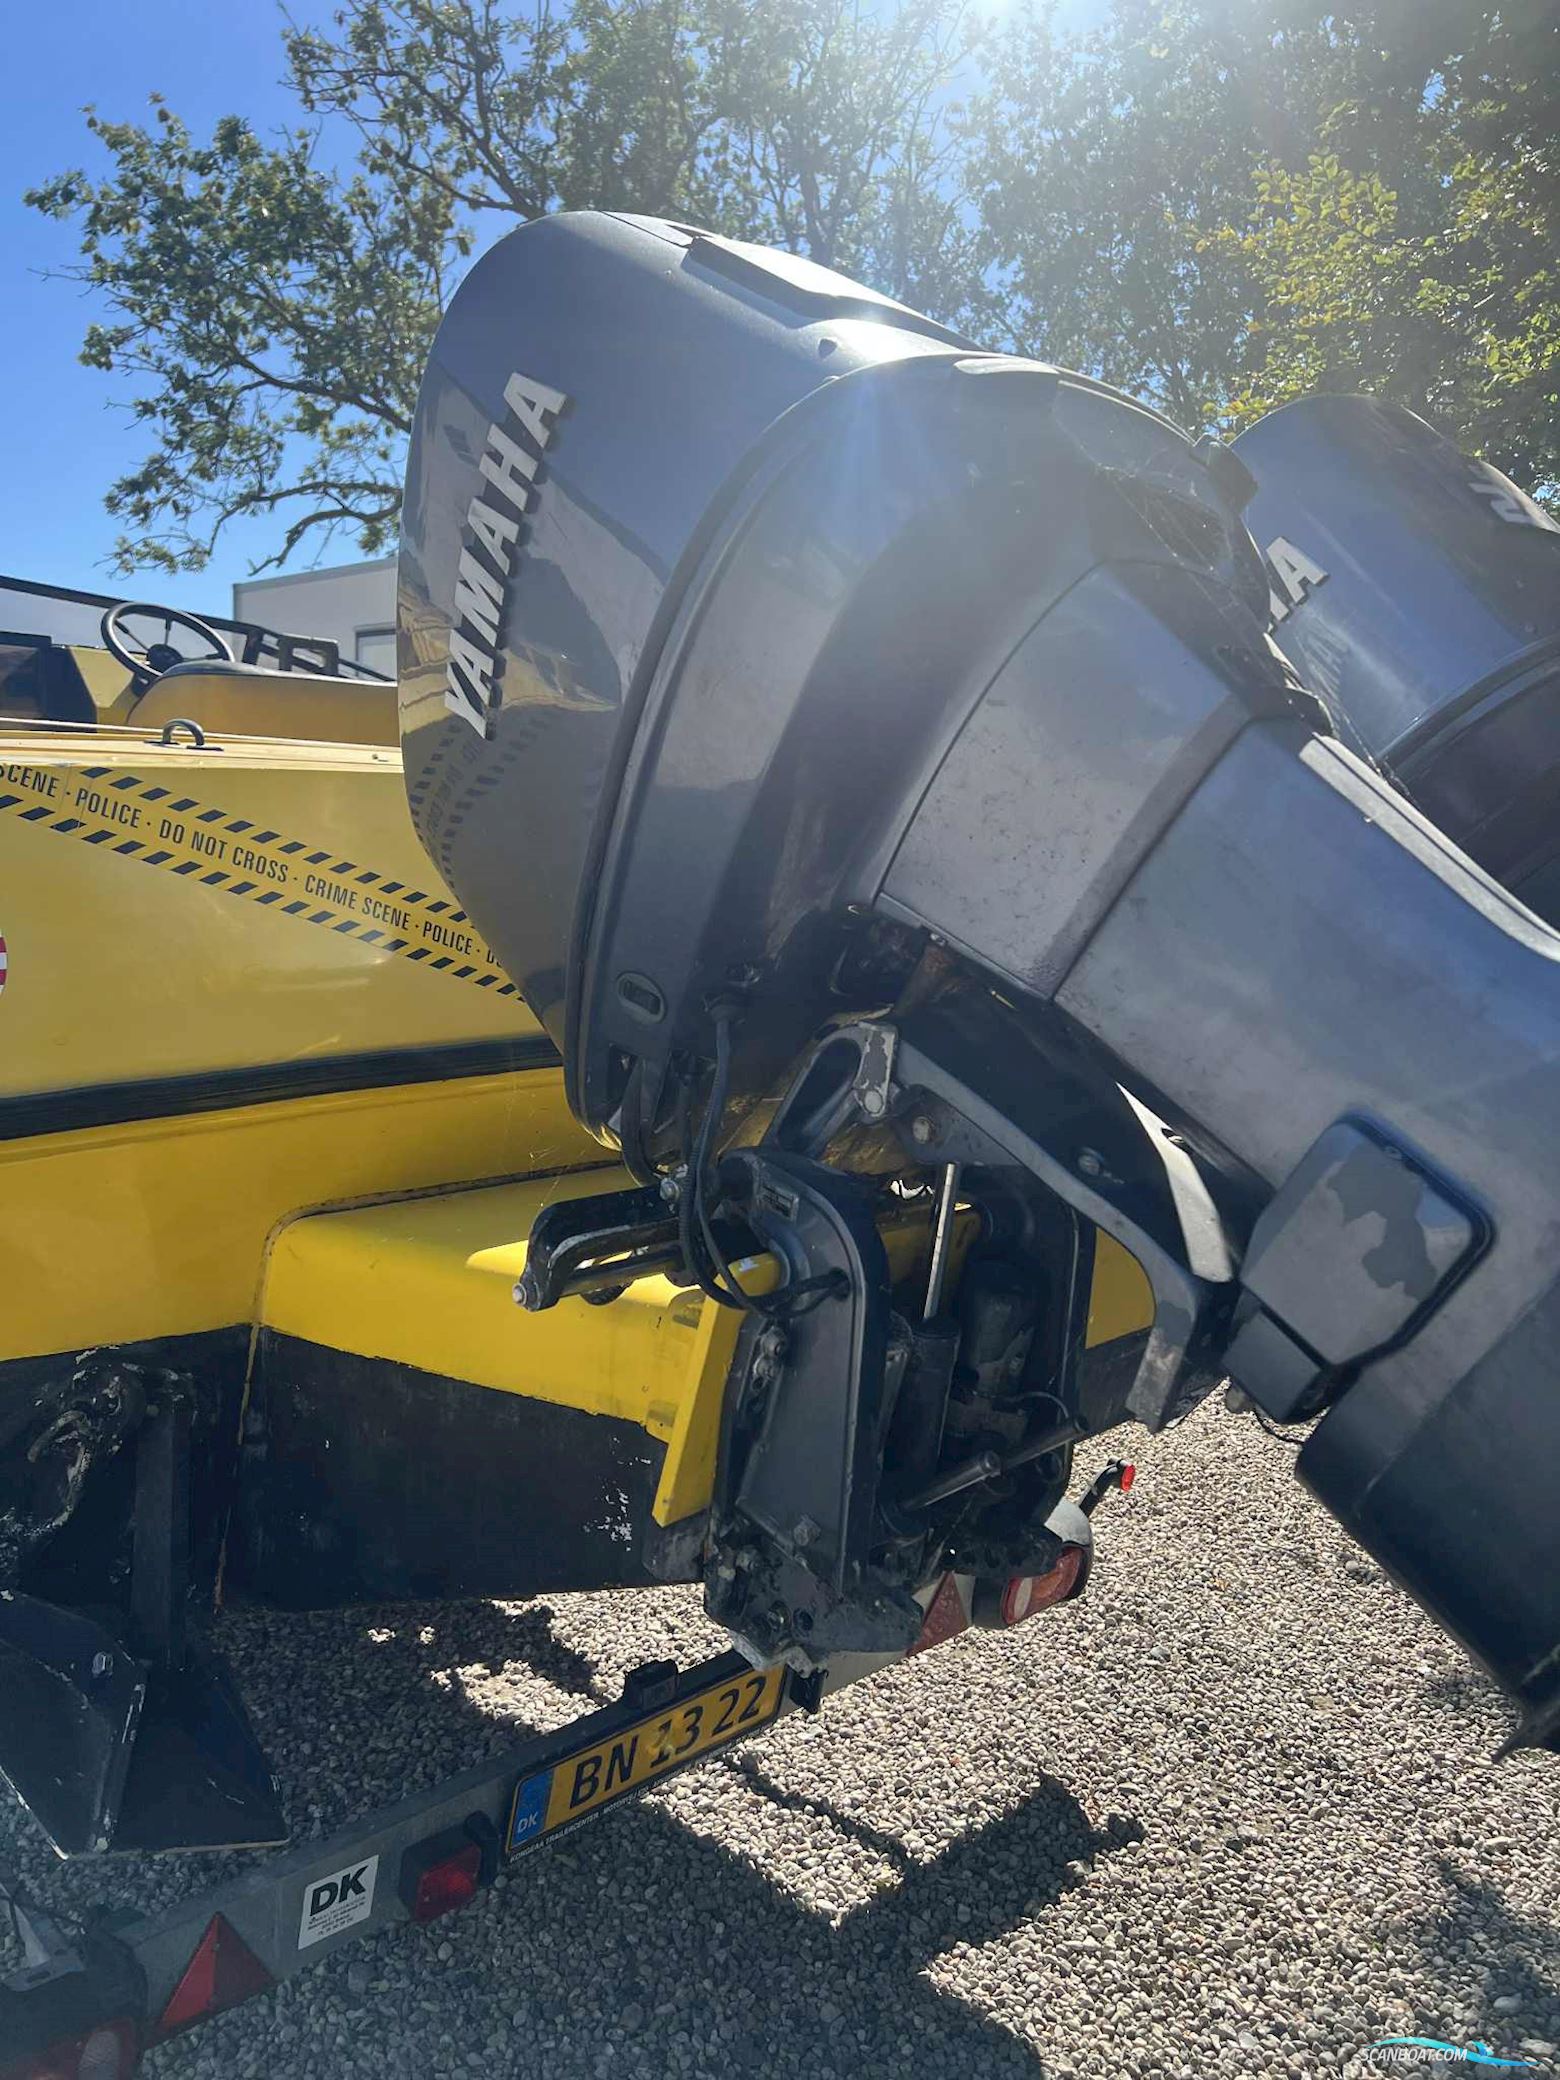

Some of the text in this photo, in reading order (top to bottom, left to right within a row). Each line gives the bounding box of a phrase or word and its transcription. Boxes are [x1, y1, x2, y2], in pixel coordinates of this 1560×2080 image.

[444, 371, 568, 739] YAMAHA
[75, 787, 142, 829] POLICE
[159, 818, 185, 844] DO
[191, 831, 228, 860] NOT
[232, 847, 289, 883] CROSS
[304, 874, 358, 910] CRIME
[362, 897, 411, 931] SCENE
[423, 920, 474, 956] POLICE
[569, 1734, 640, 1810] BN
[650, 1706, 704, 1769] 13
[711, 1676, 767, 1737] 22
[517, 1811, 539, 1834] DK
[310, 1865, 369, 1917] DK
